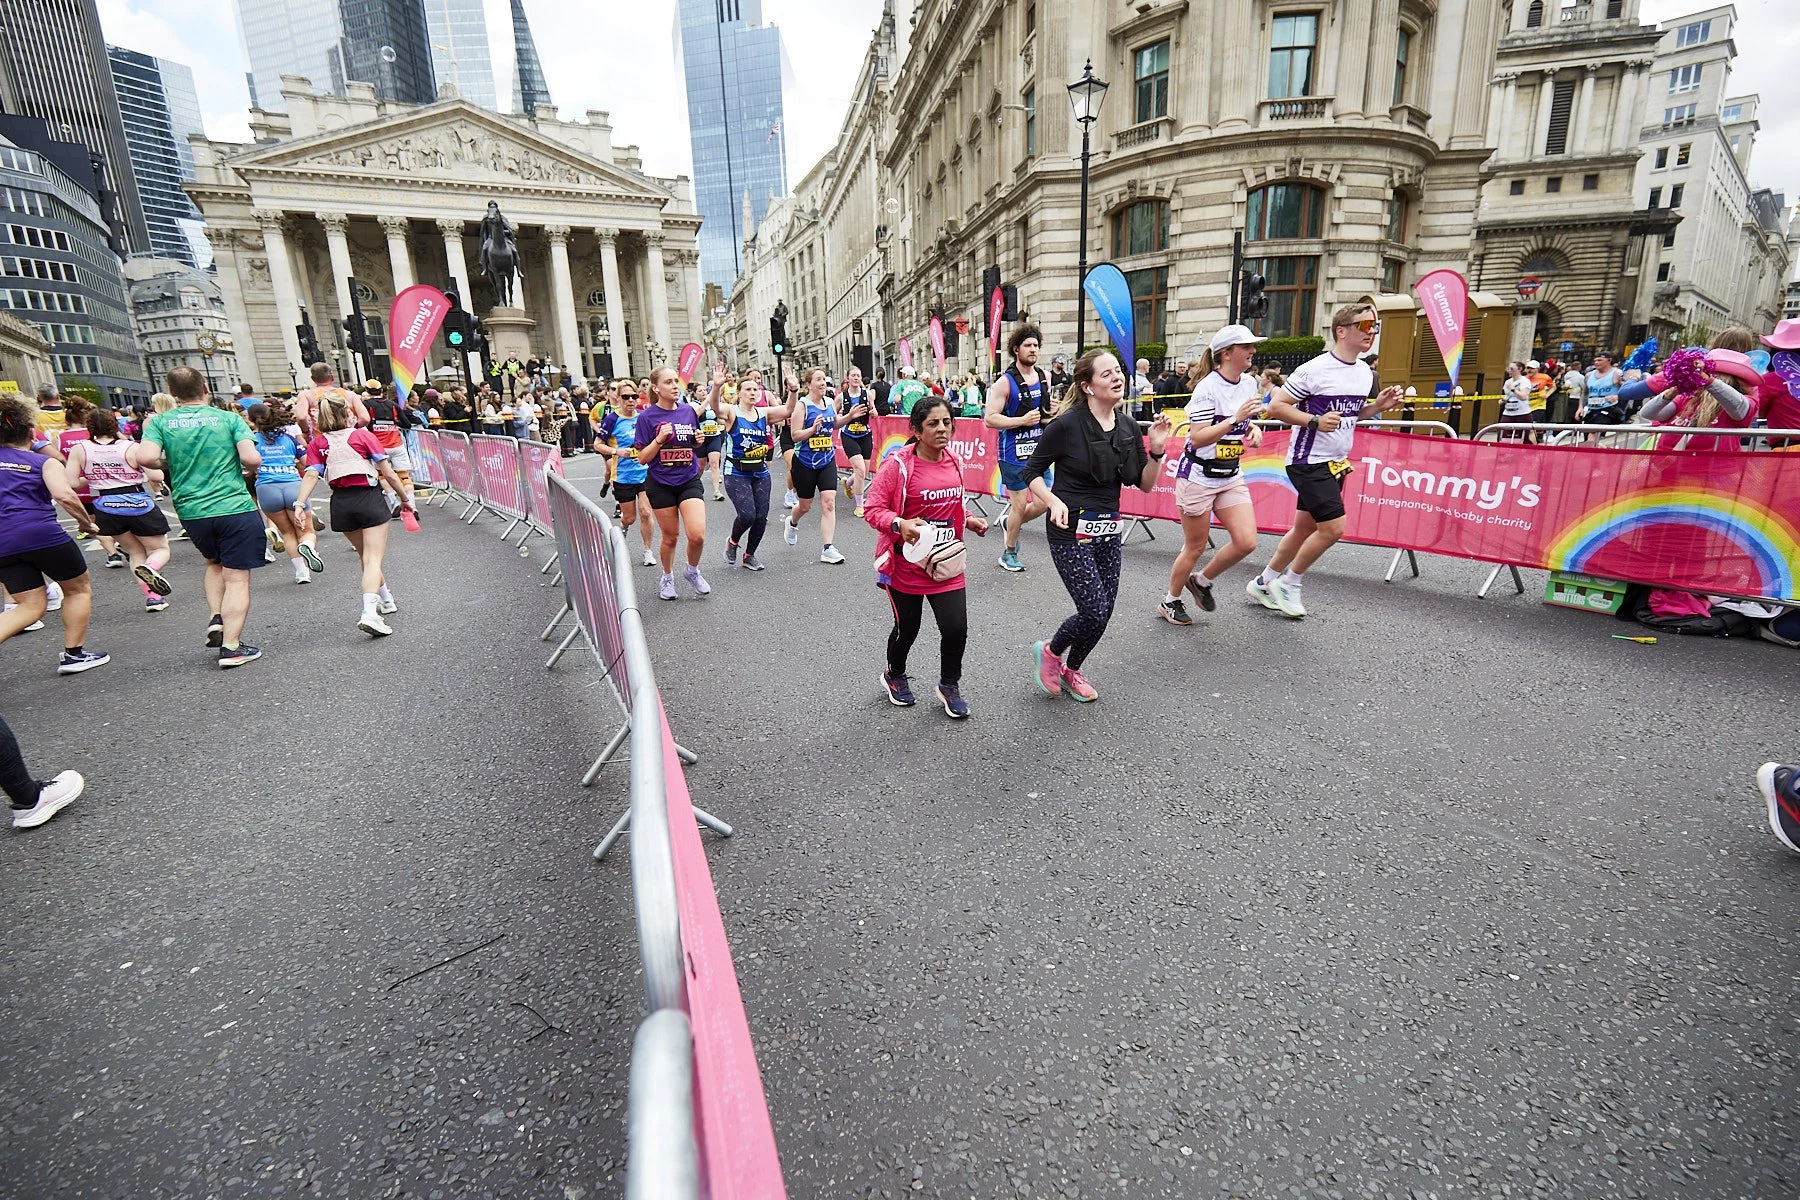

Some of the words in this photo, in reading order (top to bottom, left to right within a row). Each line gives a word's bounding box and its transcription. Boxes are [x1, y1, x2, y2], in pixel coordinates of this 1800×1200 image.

[399, 298, 433, 350] Tommy's
[681, 349, 697, 373] Tommy's
[1015, 428, 1044, 440] JAME
[662, 451, 691, 460] 17236
[947, 438, 986, 460] my's
[920, 485, 963, 501] Tommy
[1361, 456, 1542, 511] Tommy's
[1357, 494, 1376, 504] The
[1378, 496, 1434, 513] pregnancy
[1435, 506, 1452, 516] and
[1454, 508, 1484, 524] baby
[1487, 515, 1532, 531] charity
[935, 529, 953, 542] 110
[1084, 521, 1117, 534] 9579
